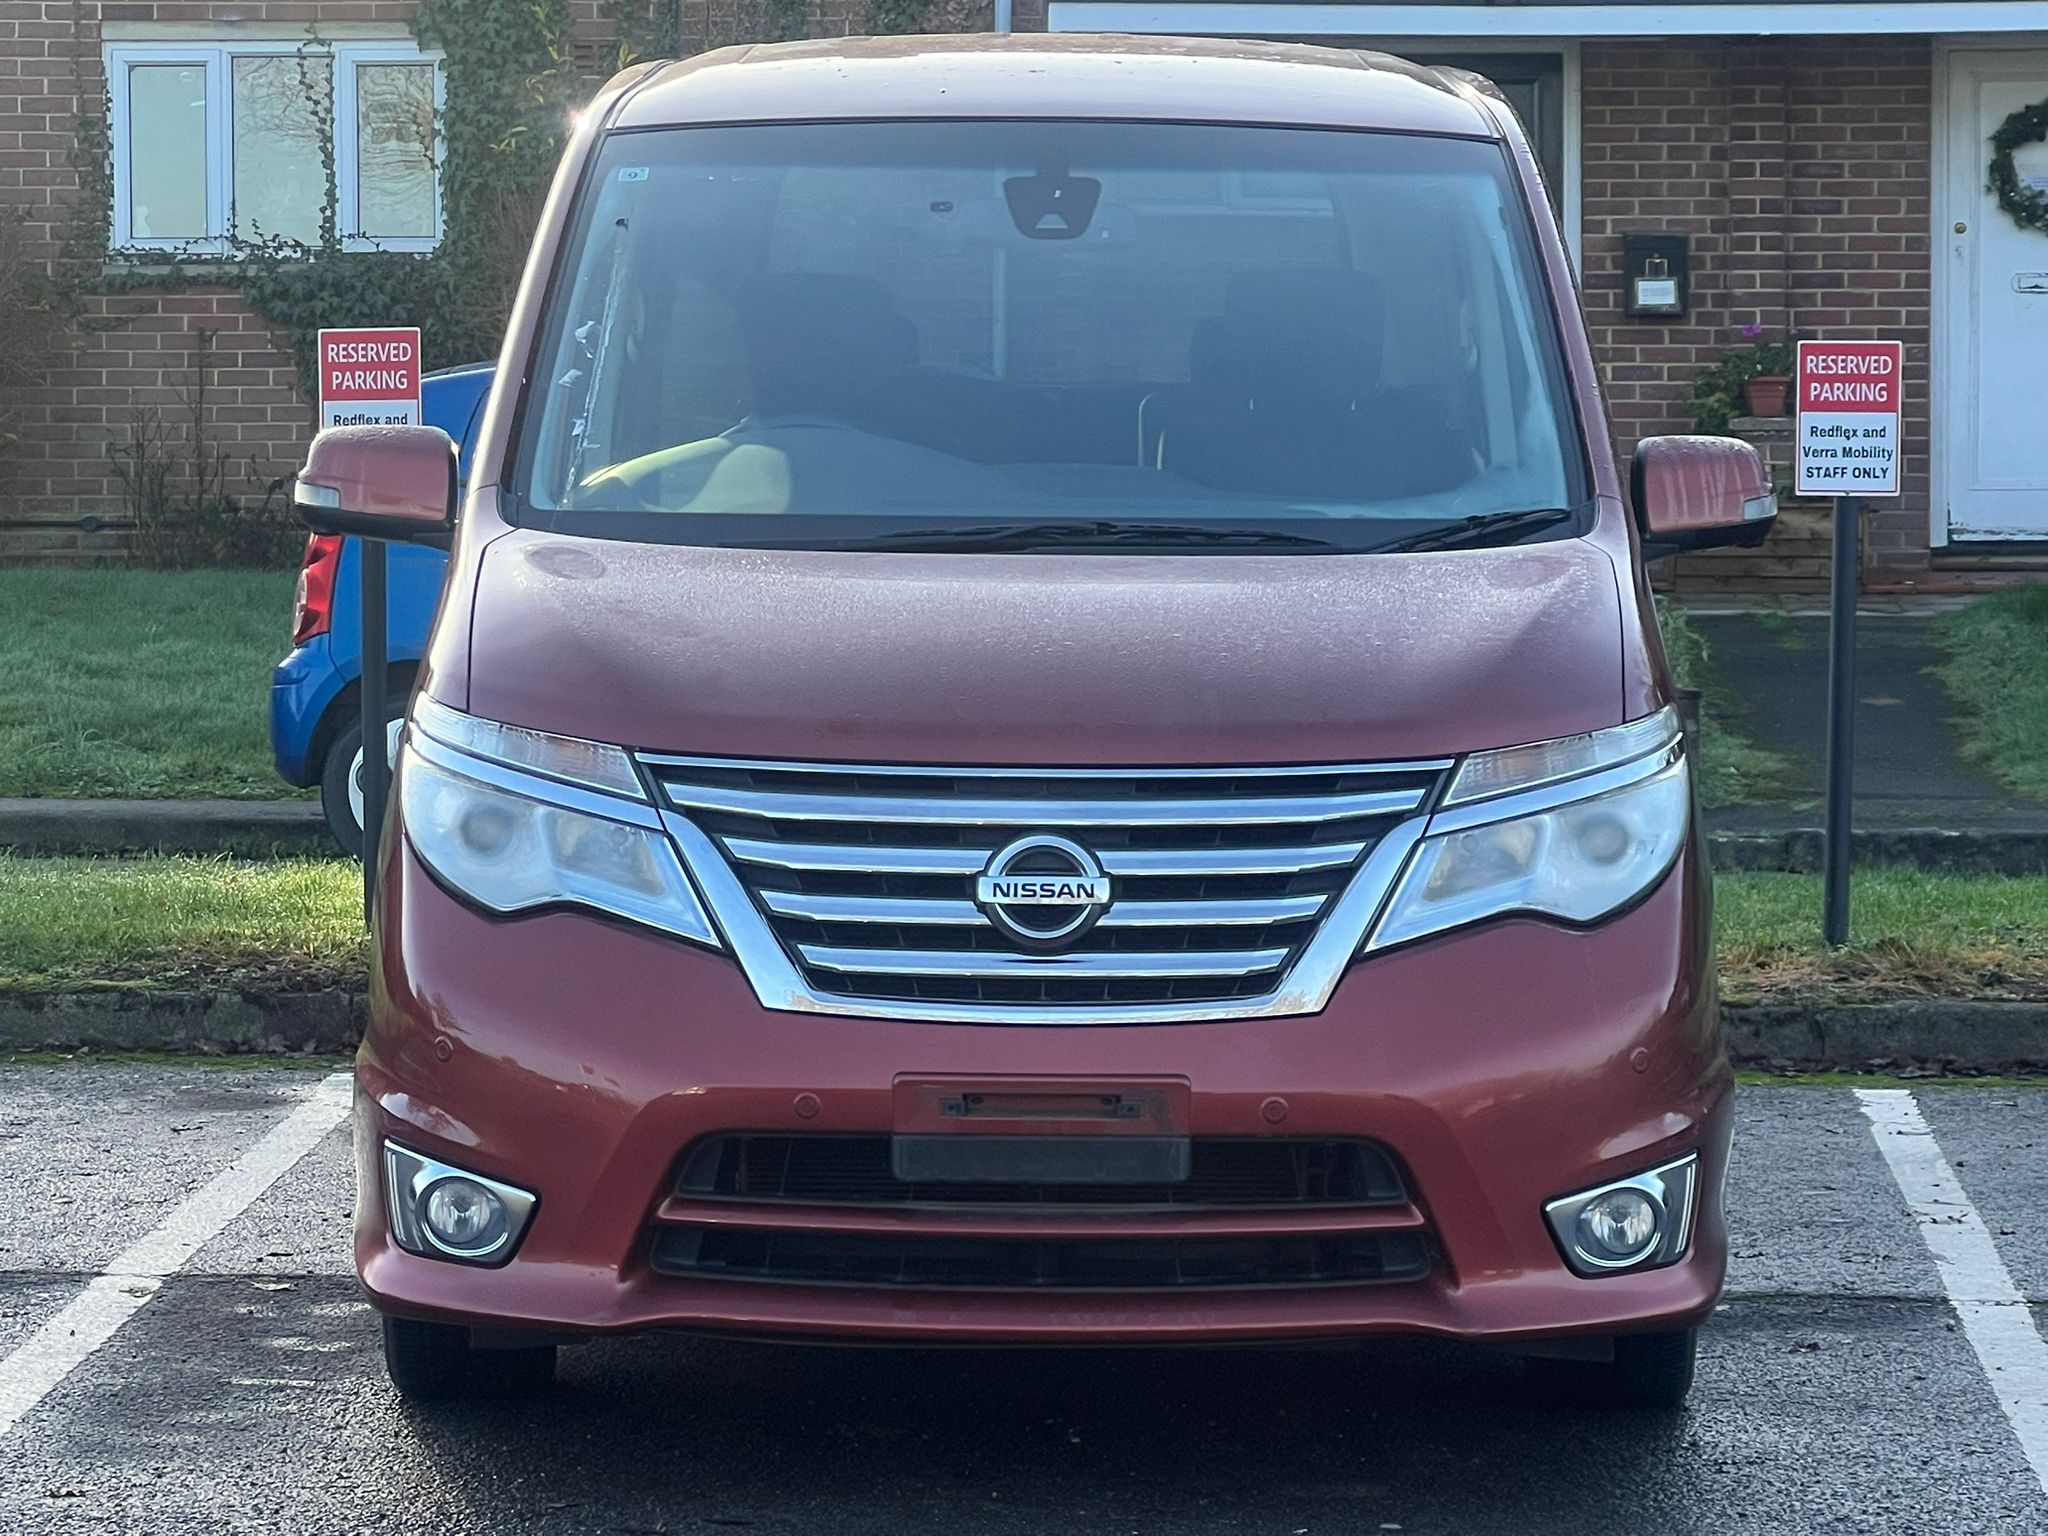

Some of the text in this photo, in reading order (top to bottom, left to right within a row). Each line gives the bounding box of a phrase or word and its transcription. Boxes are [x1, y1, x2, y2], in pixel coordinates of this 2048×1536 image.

[327, 342, 412, 363] RESERVED
[1806, 355, 1893, 375] RESERVED
[332, 370, 408, 390] PARKING
[1810, 382, 1888, 402] PARKING
[333, 413, 408, 426] Redflex and
[1810, 425, 1887, 438] Redflex and
[1802, 446, 1893, 462] Verra Mobility
[1806, 466, 1889, 479] STAFF ONLY
[993, 883, 1094, 898] NISSAN
